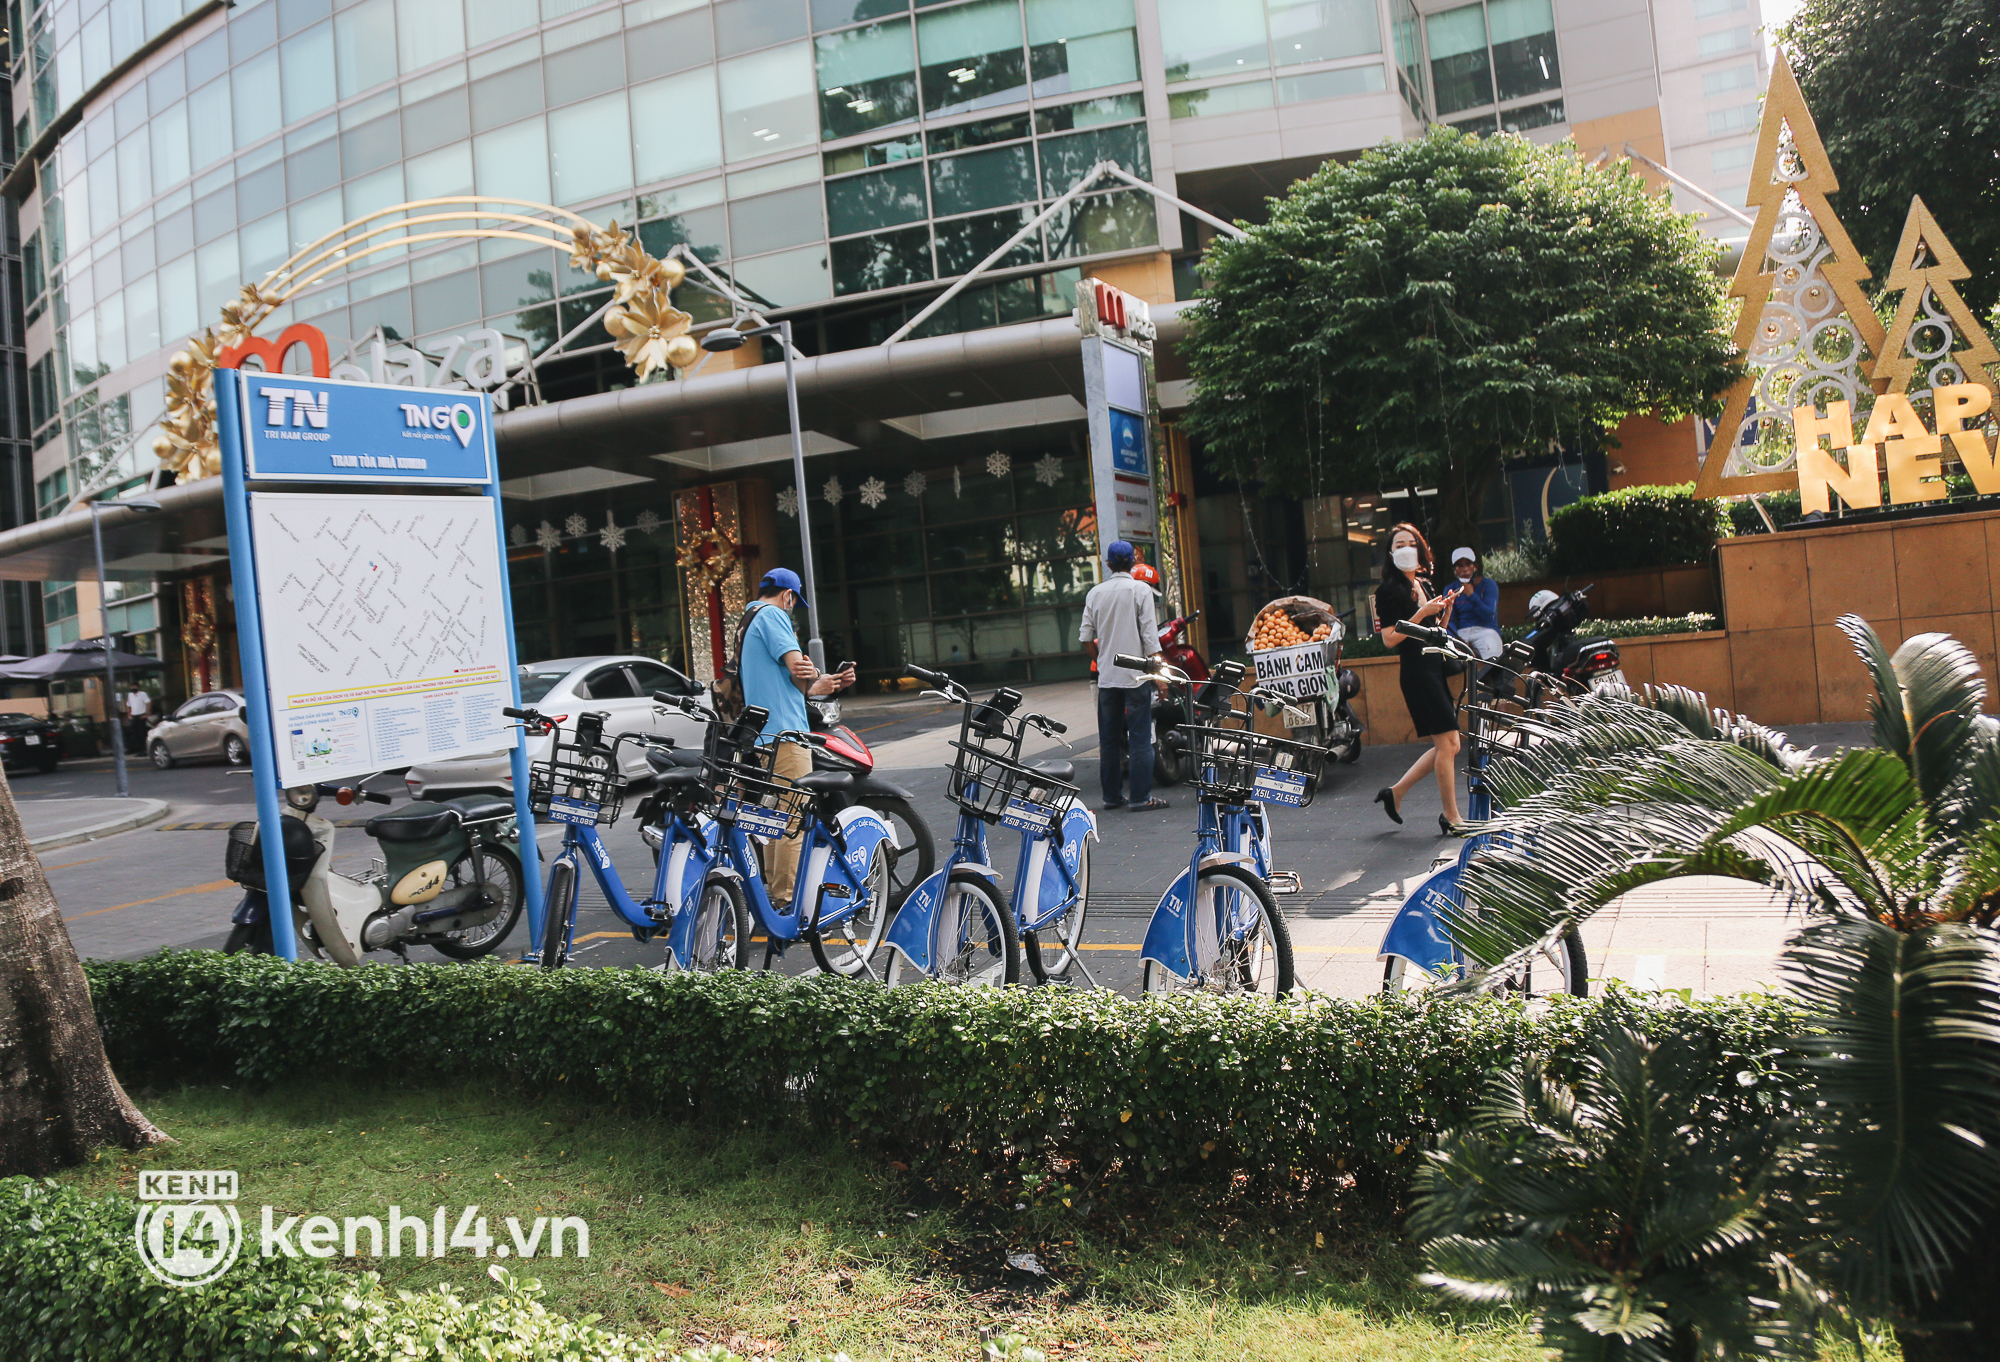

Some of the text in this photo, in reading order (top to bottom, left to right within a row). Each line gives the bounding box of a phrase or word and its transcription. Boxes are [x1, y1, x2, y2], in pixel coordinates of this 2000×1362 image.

[260, 387, 328, 428] TN
[1793, 383, 2000, 450] HAP
[264, 430, 331, 442] TRI NAM GROUP
[1256, 651, 1324, 679] BÁNH CAM
[844, 846, 867, 867] NGO
